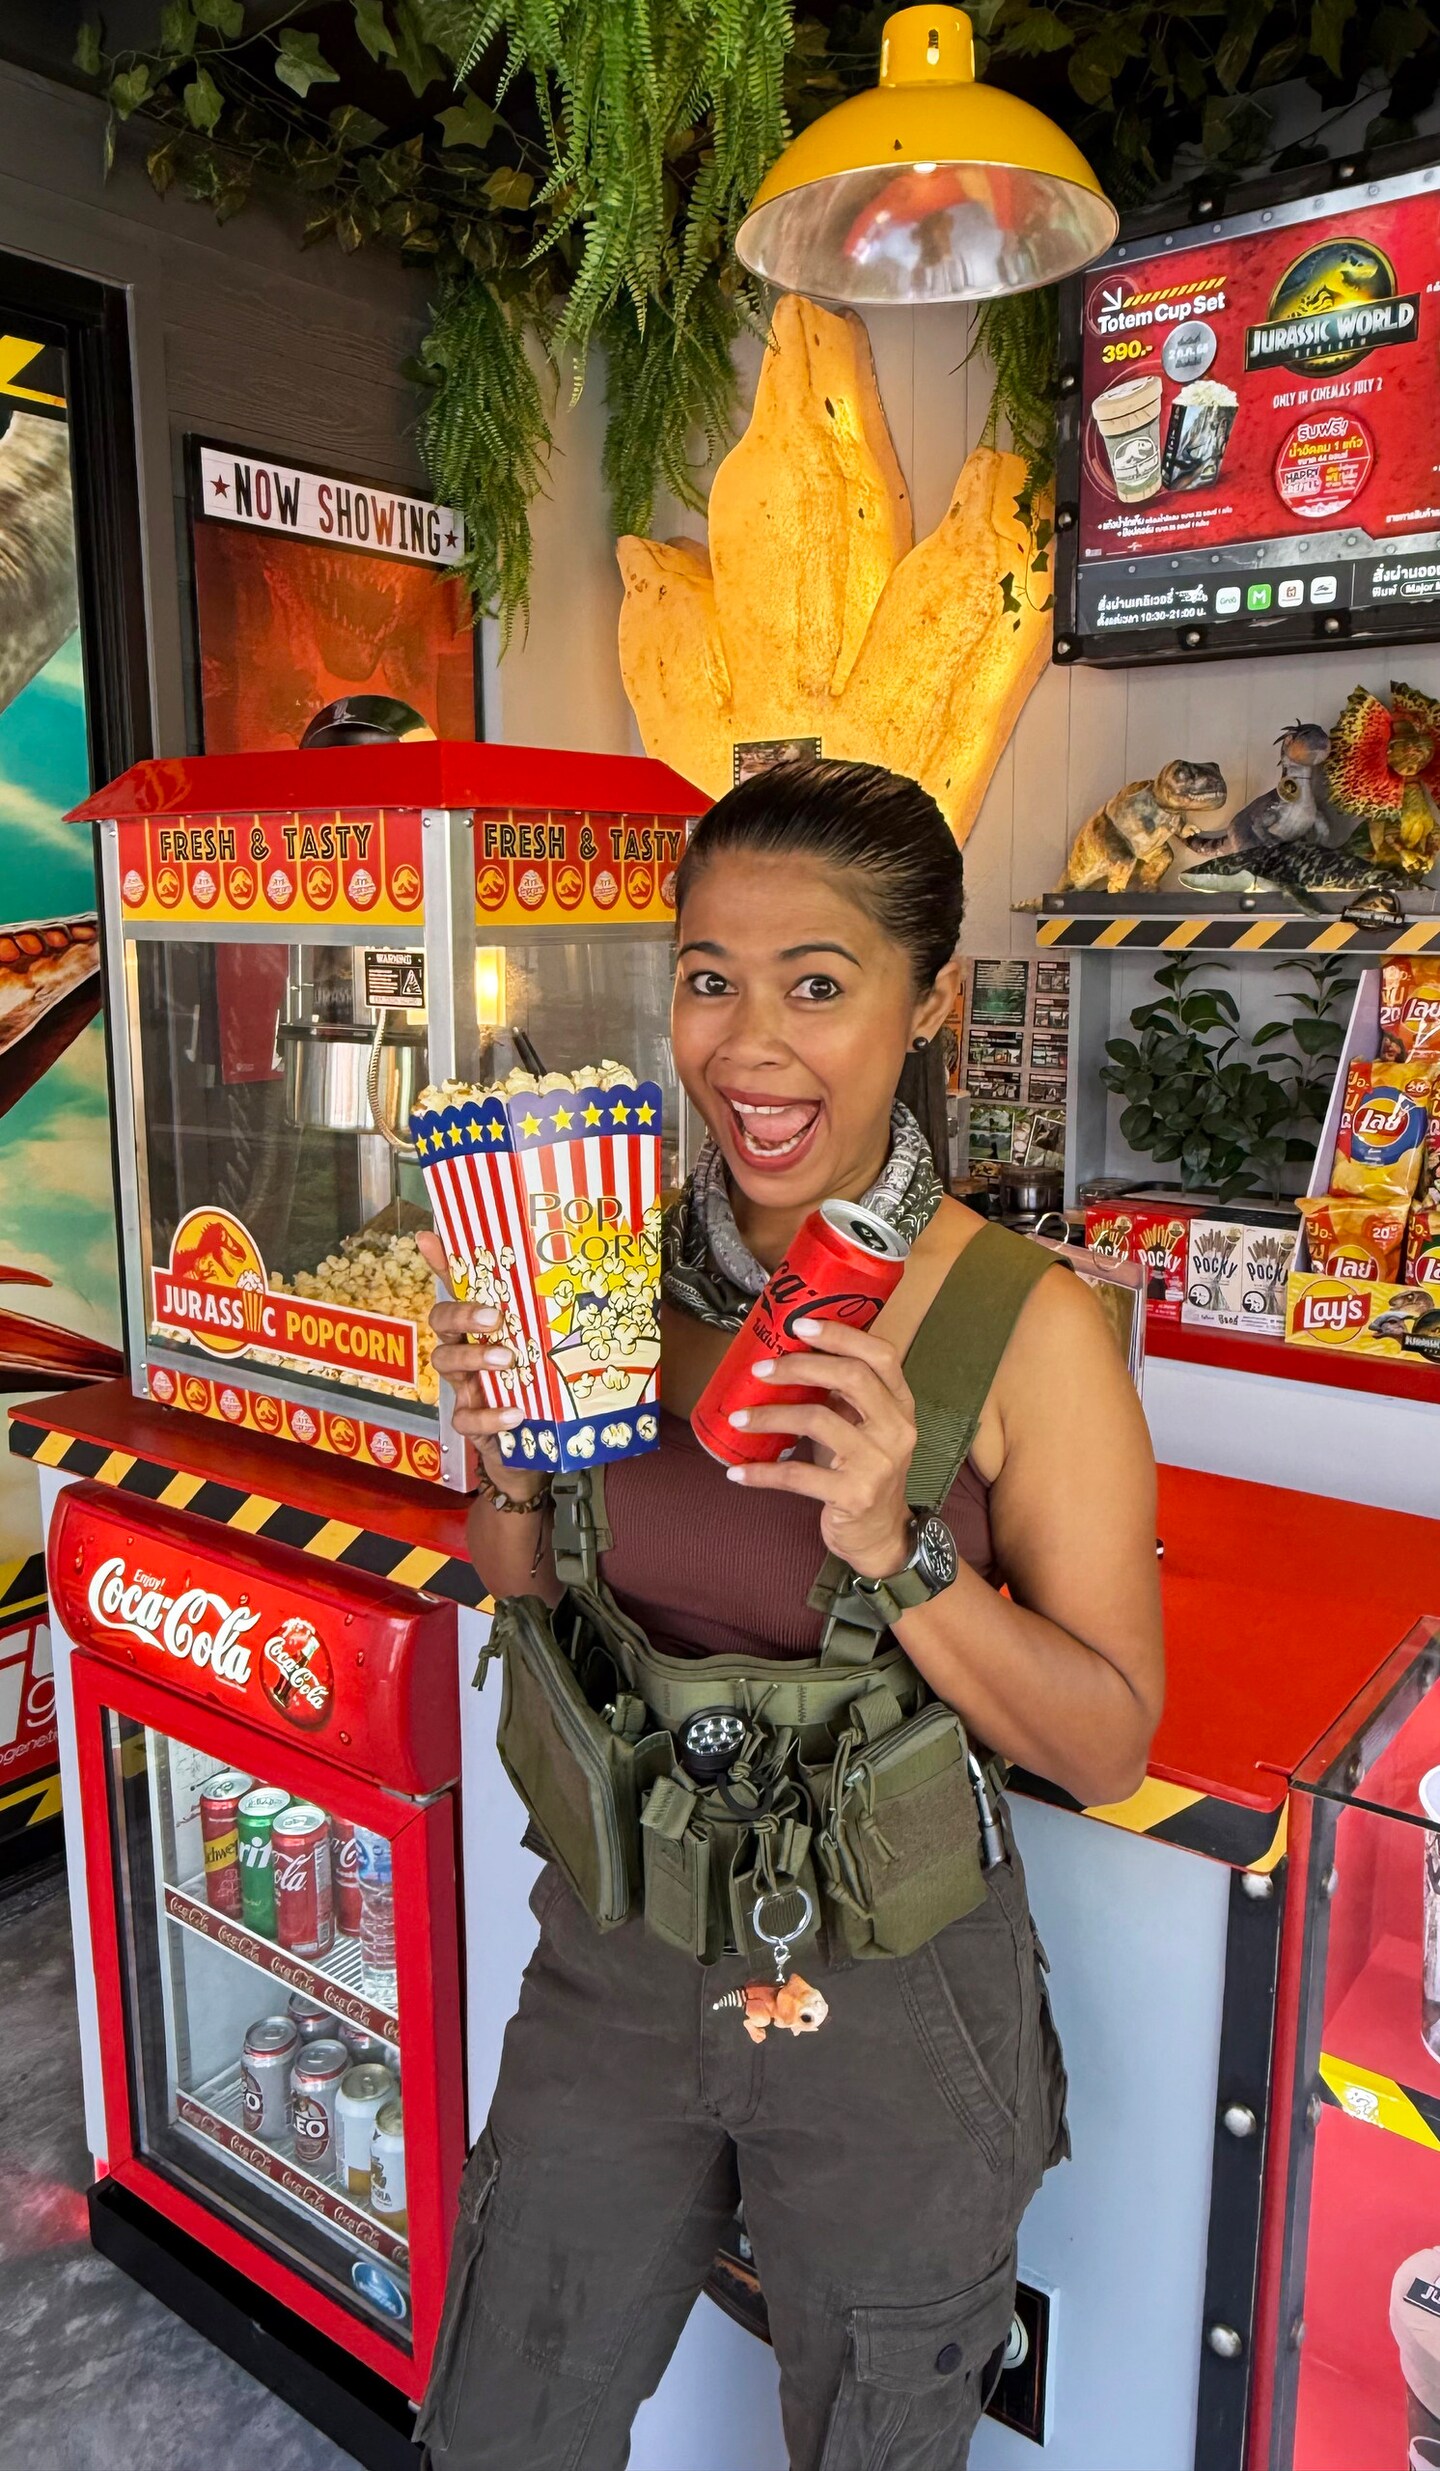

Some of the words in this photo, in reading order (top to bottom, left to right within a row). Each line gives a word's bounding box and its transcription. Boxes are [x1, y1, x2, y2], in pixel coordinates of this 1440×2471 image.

[1097, 310, 1153, 335] Totem
[1154, 303, 1191, 322] Cup
[1193, 292, 1226, 315] Set
[1250, 321, 1330, 358] JURASSIC
[1336, 303, 1415, 341] WORLD
[1272, 391, 1296, 409] ONLY
[1297, 389, 1308, 405] IN
[1310, 382, 1351, 404] CINEMAS
[1352, 378, 1374, 396] JULY
[1376, 377, 1383, 391] 2
[234, 463, 300, 526] NOW
[318, 484, 441, 557] SHOWING
[159, 829, 236, 862] FRESH
[250, 827, 269, 861] &
[283, 822, 373, 861] TASTY
[483, 822, 566, 861] FRESH
[579, 825, 599, 861] &
[608, 826, 682, 863] TASTY
[1138, 1248, 1182, 1273] POCKY
[1192, 1255, 1238, 1279] POCKY
[1303, 1294, 1365, 1331] Lay's
[286, 1309, 406, 1367] POPCORN
[133, 1568, 166, 1592] Enjoy!
[88, 1557, 262, 1684] Coca-Cola
[264, 1636, 329, 1710] Coca-Cola
